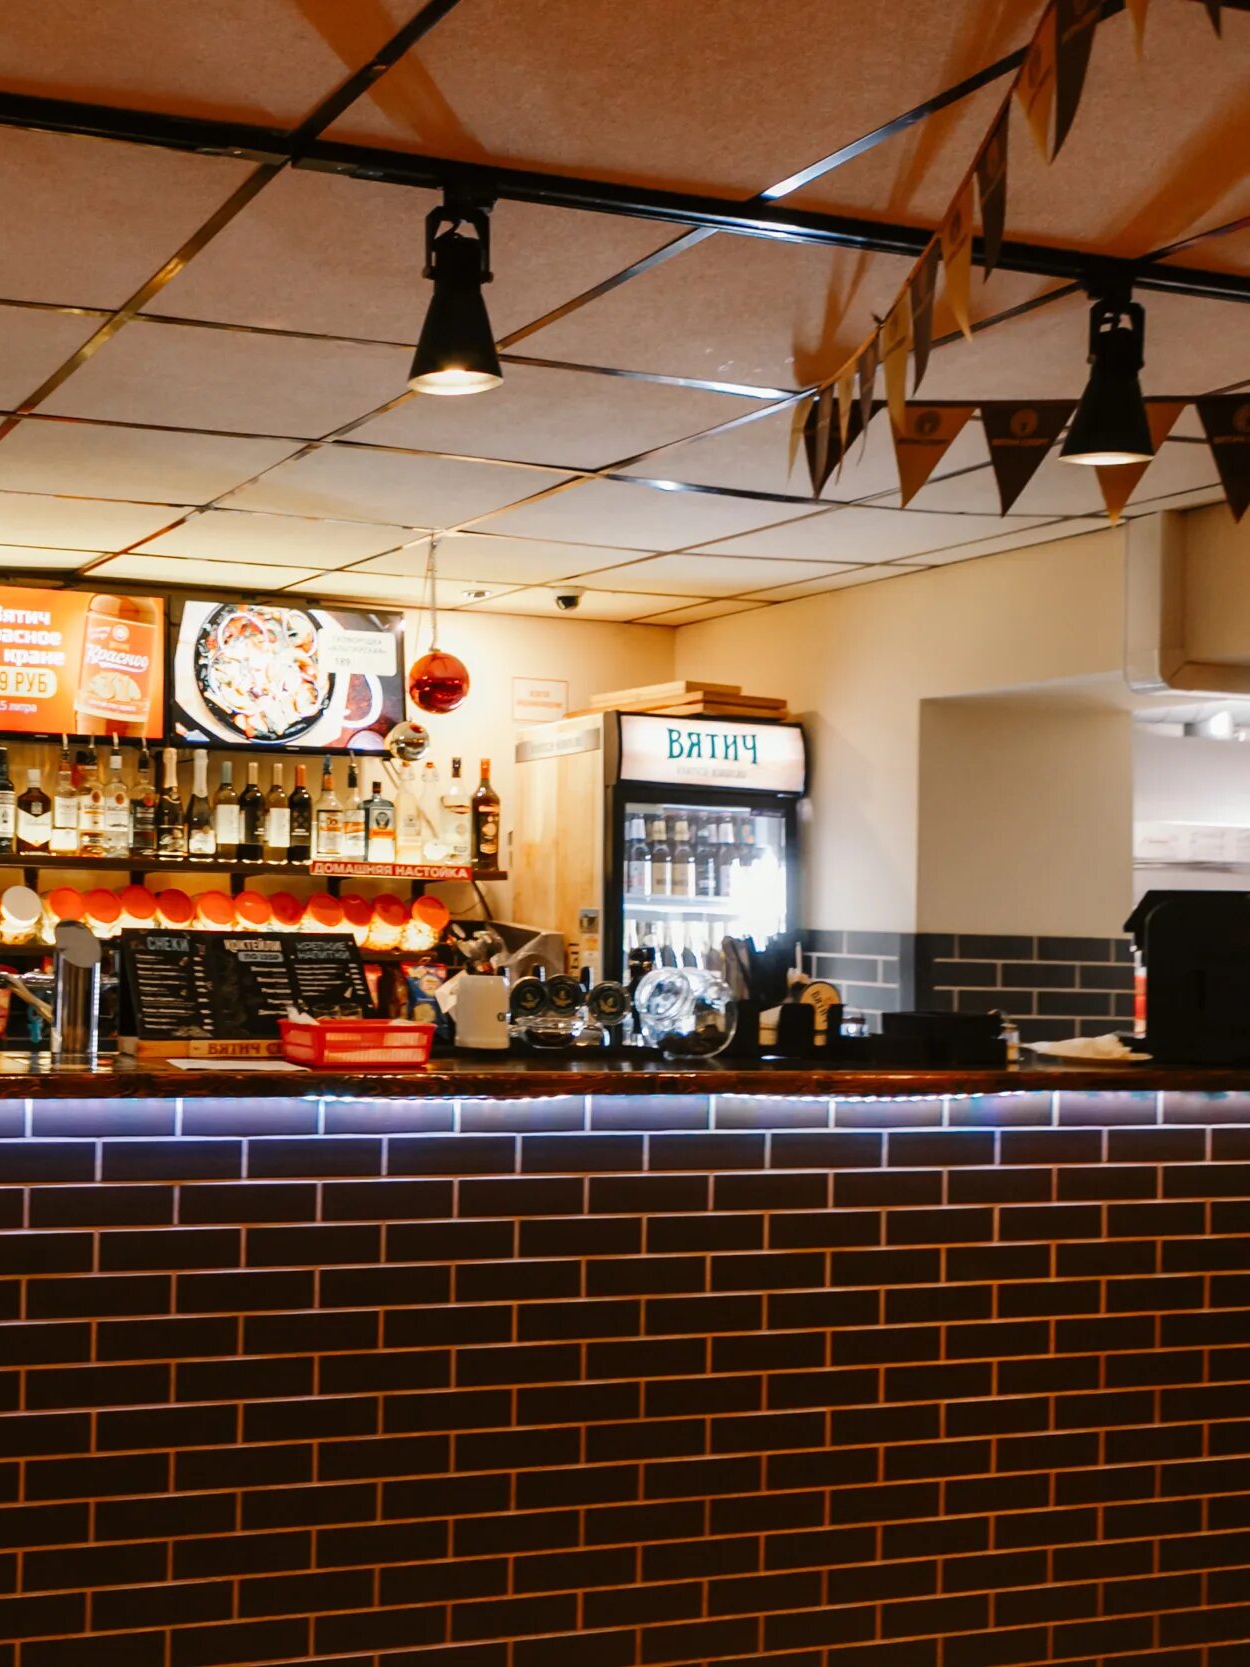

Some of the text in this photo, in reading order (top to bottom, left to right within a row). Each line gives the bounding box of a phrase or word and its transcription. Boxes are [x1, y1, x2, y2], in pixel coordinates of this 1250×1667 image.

[4, 649, 66, 667] кране
[15, 672, 48, 693] РУБ
[667, 728, 758, 765] ВЯТИЧ
[314, 862, 468, 878] ДОМАШНЯЯ НАСТОЙКА
[146, 937, 189, 951] СНЕКИ
[208, 1042, 261, 1055] ВЯТИЧ
